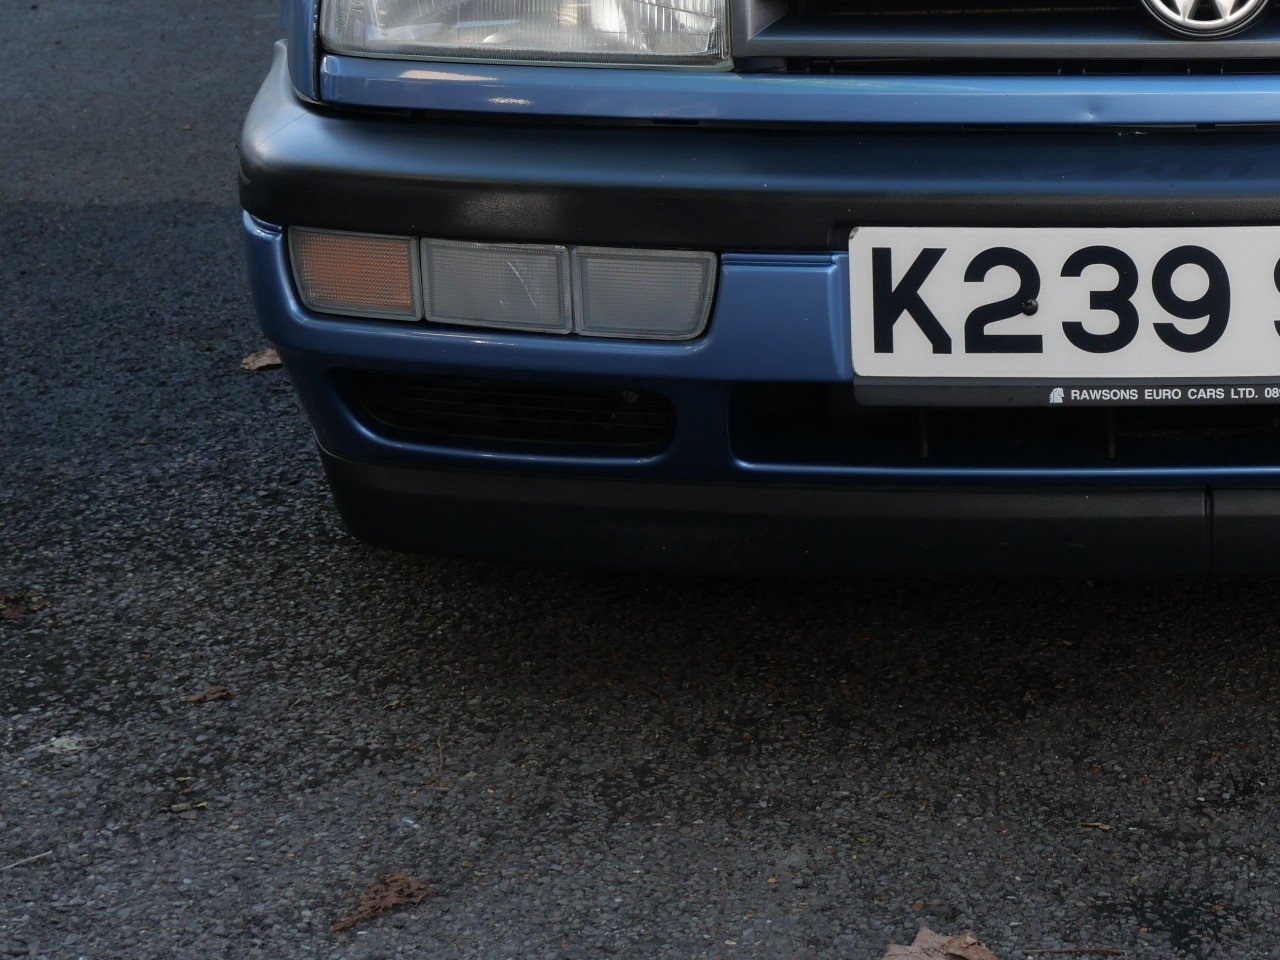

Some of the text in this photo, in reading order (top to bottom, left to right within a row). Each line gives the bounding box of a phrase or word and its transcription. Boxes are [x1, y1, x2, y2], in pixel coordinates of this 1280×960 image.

[871, 243, 1232, 355] K239
[1070, 389, 1139, 401] RAWSONS
[1144, 388, 1184, 400] EURO
[1187, 388, 1226, 400] CARS
[1230, 387, 1259, 400] LTD.
